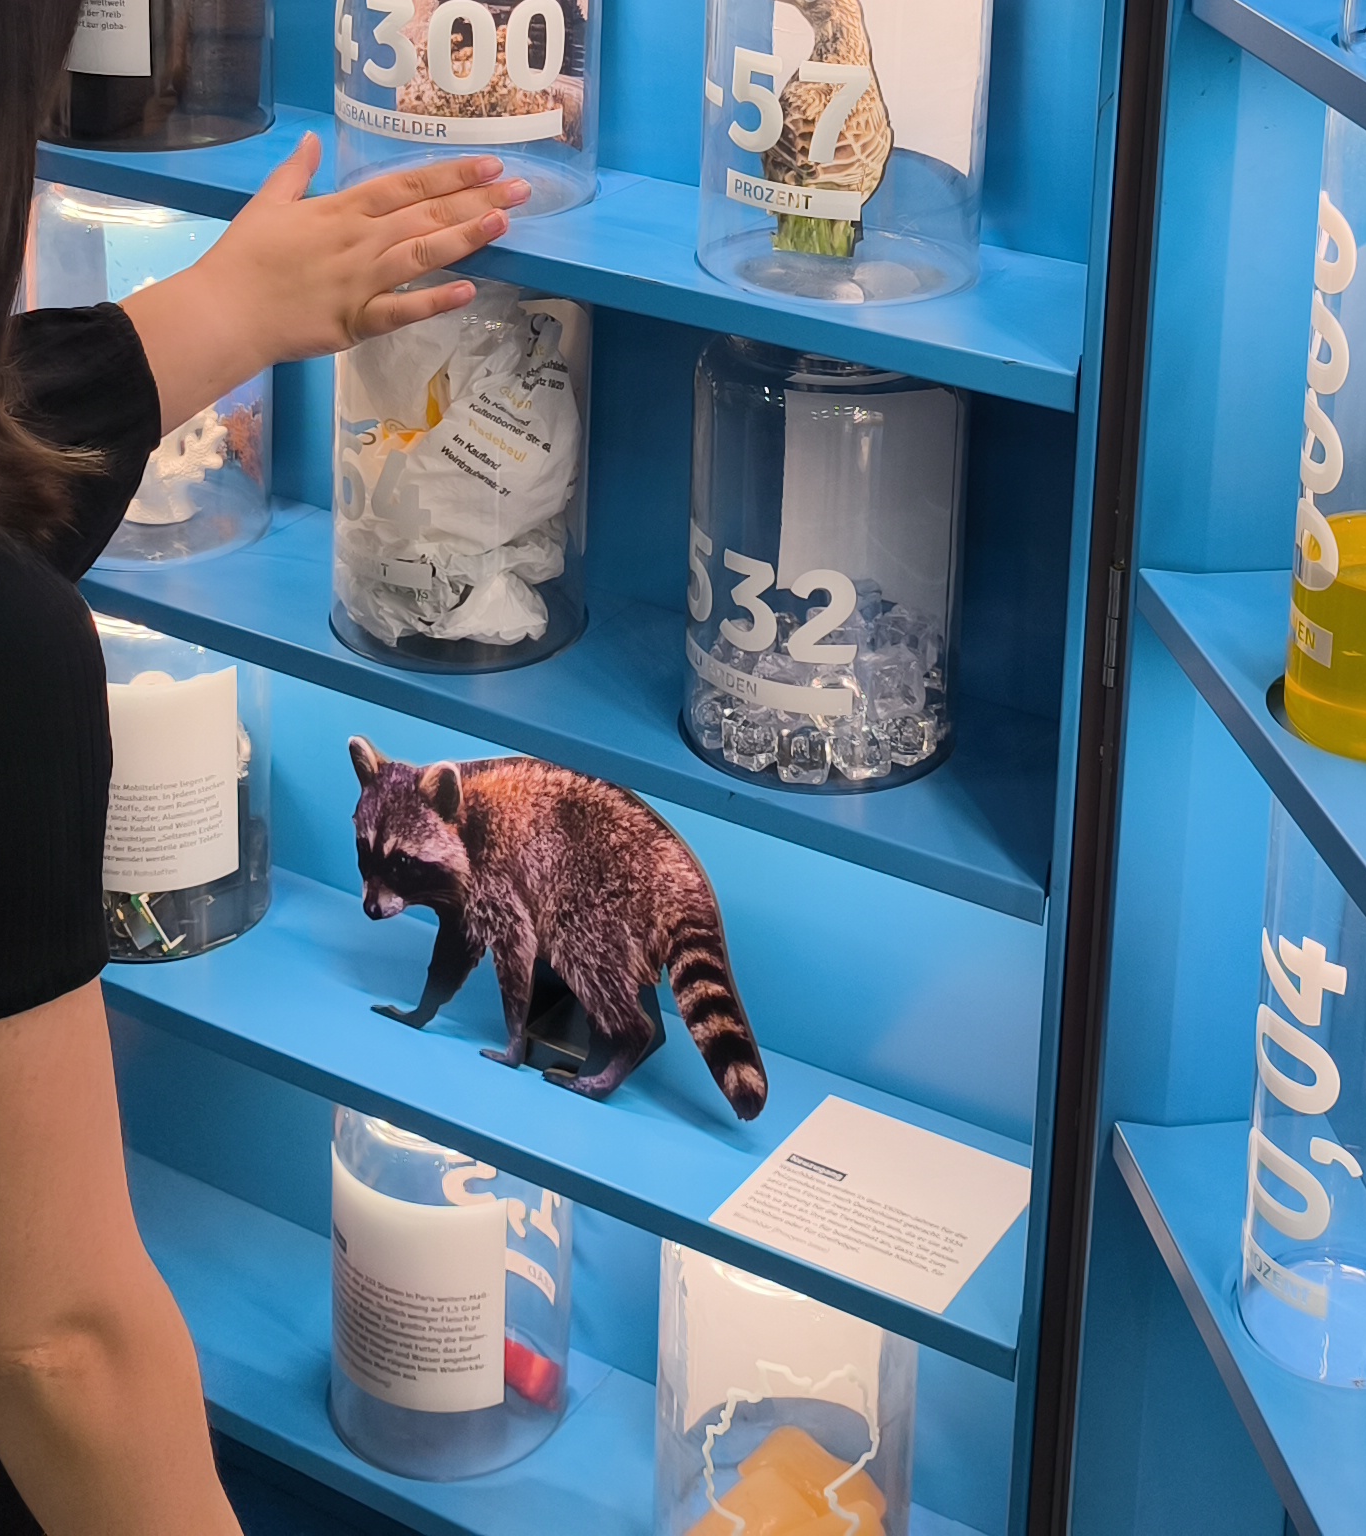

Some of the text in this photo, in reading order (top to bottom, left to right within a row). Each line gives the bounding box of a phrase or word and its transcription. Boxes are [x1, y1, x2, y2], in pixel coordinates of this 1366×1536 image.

[705, 45, 872, 164] -57
[734, 177, 813, 211] PROZENT
[452, 433, 502, 472] Im Kaufland
[686, 517, 858, 665] 532
[115, 803, 142, 812] Stoffe,
[1246, 925, 1364, 1241] 0,04
